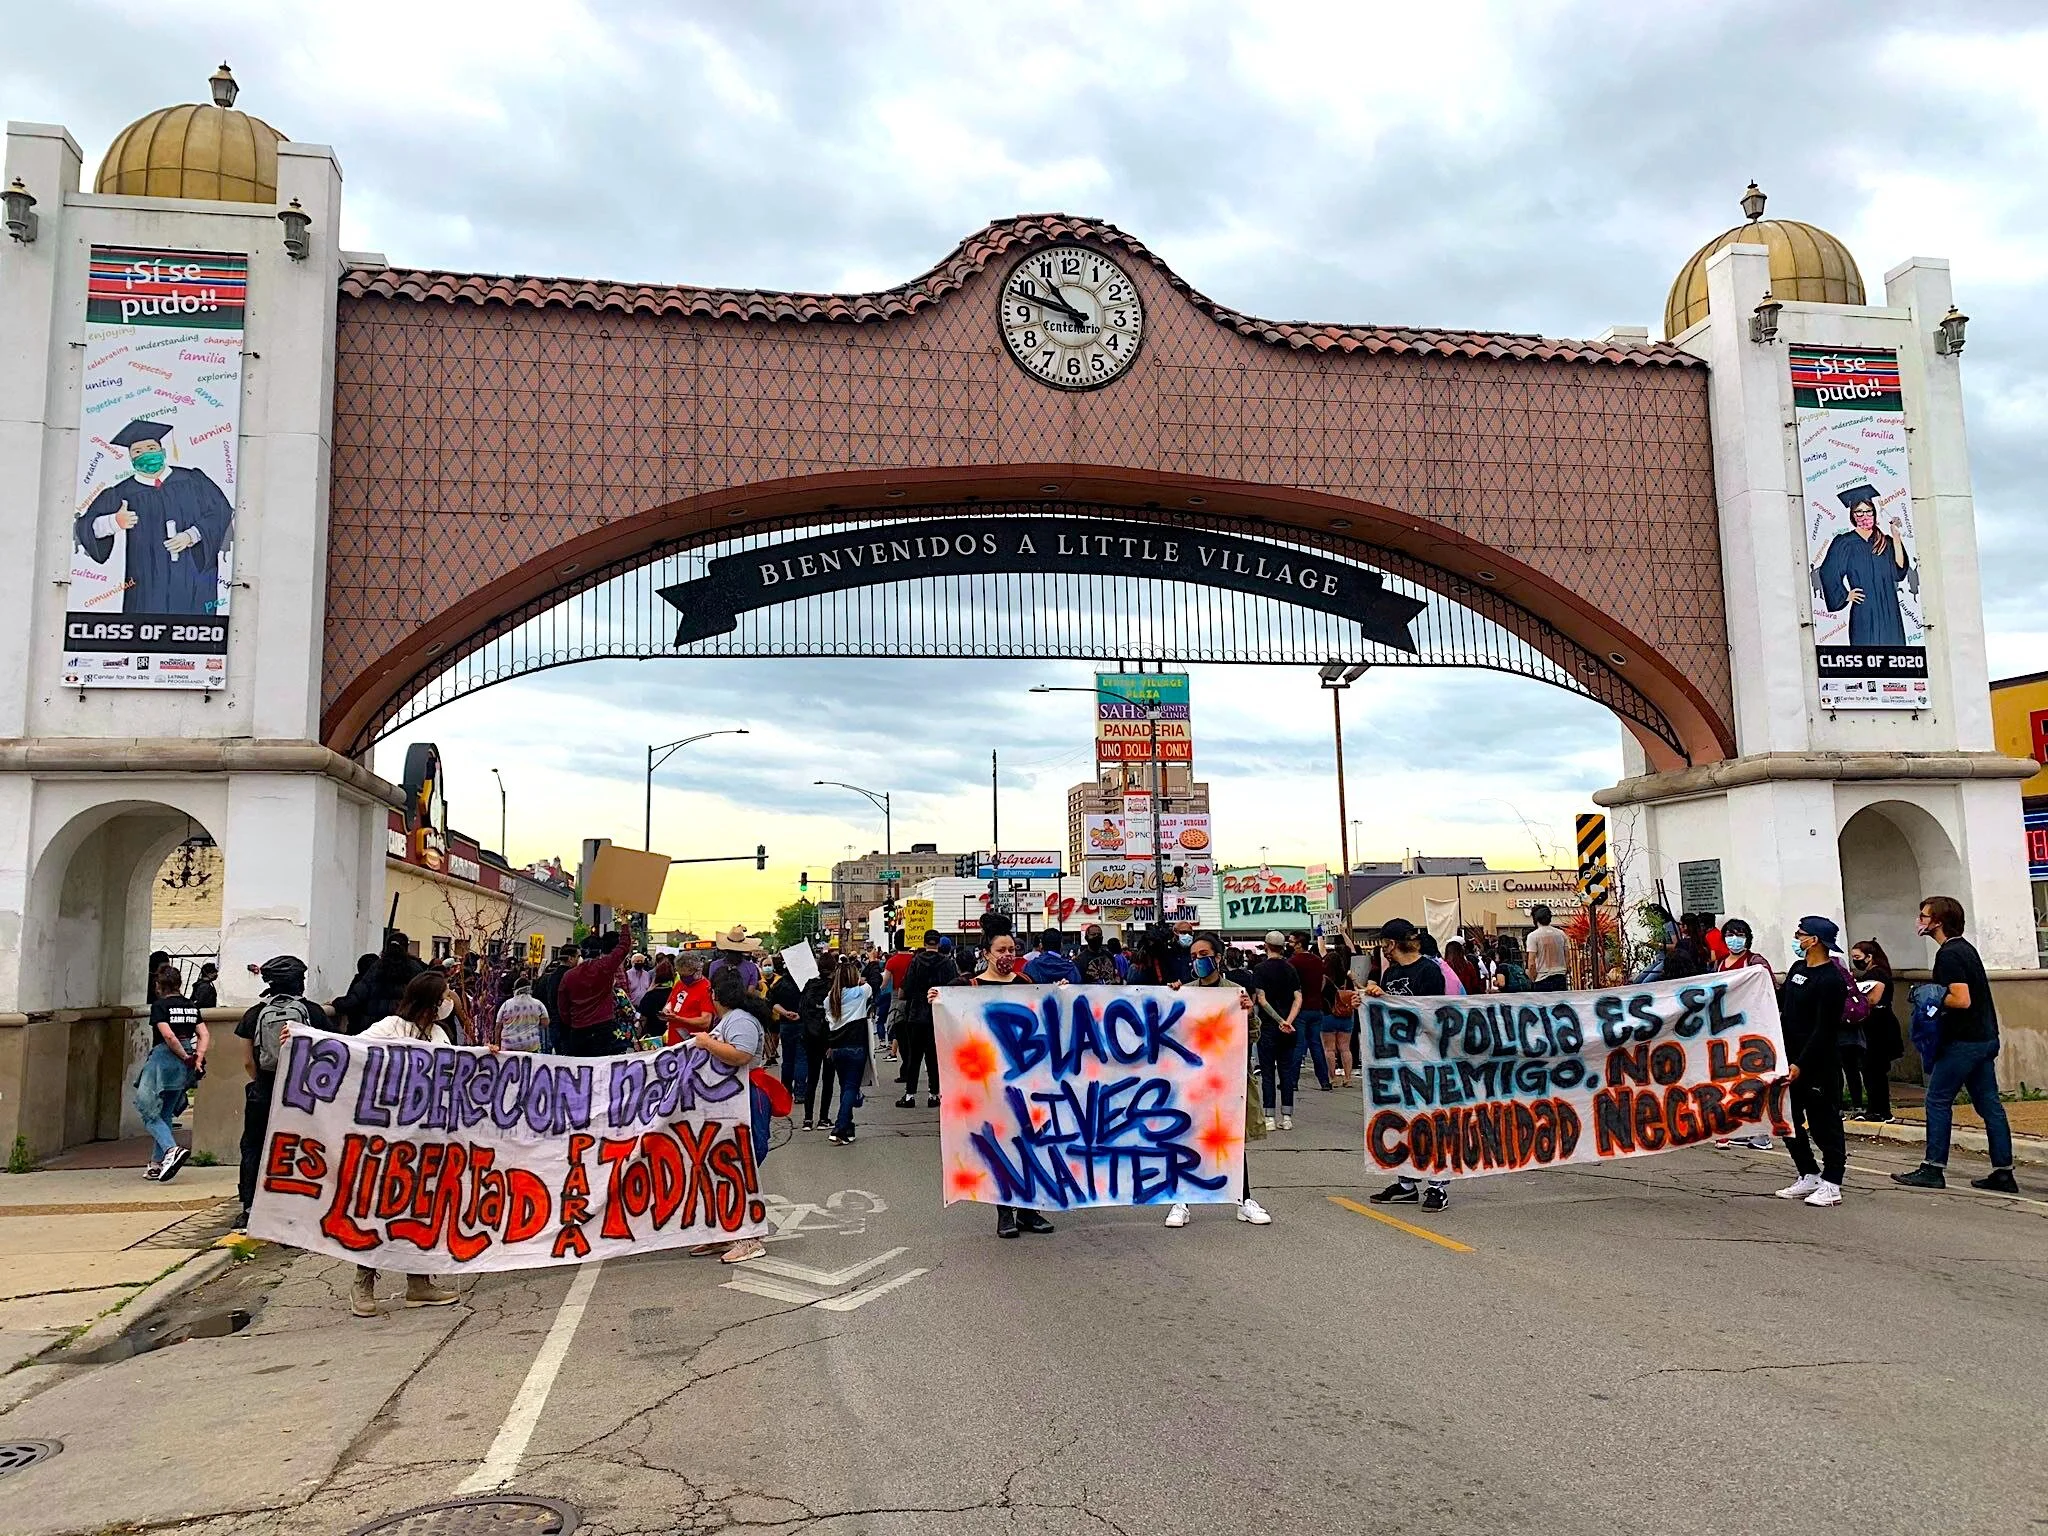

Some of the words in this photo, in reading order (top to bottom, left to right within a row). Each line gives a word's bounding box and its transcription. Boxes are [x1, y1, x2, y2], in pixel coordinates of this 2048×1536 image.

[125, 258, 162, 290] ¡Sí
[168, 263, 200, 282] se
[1040, 262, 1052, 278] 11
[1061, 258, 1080, 275] 12
[1092, 266, 1099, 282] 1
[1018, 280, 1036, 296] 10
[1108, 284, 1122, 301] 2
[121, 288, 218, 324] pudo!!
[1017, 306, 1030, 323] 9
[1043, 320, 1100, 334] Centenario
[1114, 310, 1126, 327] 3
[88, 326, 136, 341] enjoying
[204, 336, 243, 347] changing
[1024, 330, 1037, 348] 8
[1106, 334, 1118, 350] 4
[136, 334, 199, 351] understanding
[88, 345, 129, 371] celebrating
[178, 349, 226, 364] familia
[1042, 350, 1056, 368] 7
[1092, 354, 1104, 371] 5
[128, 360, 173, 381] respecting
[1067, 358, 1080, 375] 6
[1816, 354, 1839, 380] ¡Sí
[1844, 356, 1866, 374] se
[86, 376, 123, 391] uniting
[197, 371, 238, 386] exploring
[86, 396, 122, 414] together
[125, 392, 134, 400] as
[136, 386, 152, 396] one
[154, 388, 196, 406] amig@s
[194, 386, 224, 408] amor
[1816, 378, 1882, 408] pudo!!
[130, 406, 178, 421] supporting
[1799, 409, 1830, 422] enjoying
[1876, 418, 1905, 426] changing
[1831, 415, 1874, 431] understanding
[189, 422, 232, 447] learning
[1862, 428, 1894, 440] familia
[90, 434, 124, 461] growing
[1828, 438, 1860, 454] respecting
[1876, 446, 1905, 457] exploring
[223, 440, 234, 484] connecting
[1803, 452, 1828, 463] uniting
[84, 452, 105, 485] creating
[1876, 459, 1898, 477] amor
[1836, 475, 1868, 490] supporting
[1812, 501, 1836, 520] growing
[758, 534, 998, 586] BIENVENIDOS
[1017, 534, 1037, 554] A
[1058, 534, 1180, 562] LITTLE
[1198, 546, 1339, 596] VILLAGE
[71, 568, 108, 582] cultura
[84, 577, 136, 608] comunidad
[204, 598, 228, 612] paz
[1814, 608, 1838, 620] cultura
[1899, 600, 1922, 630] laughing
[68, 623, 134, 640] CLASS
[140, 624, 166, 641] OF
[172, 625, 224, 642] 2020
[1908, 632, 1924, 644] paz
[1820, 654, 1862, 668] CLASS
[1867, 655, 1884, 668] OF
[1888, 656, 1924, 668] 2020
[1100, 704, 1136, 718] SAH
[1104, 724, 1184, 736] PANADERIA
[1102, 744, 1120, 756] UNO
[1166, 744, 1188, 756] ONLY
[1102, 864, 1108, 872] EL
[1110, 864, 1126, 872] POLLO
[1468, 879, 1499, 893] SAH
[1226, 895, 1308, 919] PIZZER
[1516, 898, 1582, 908] ESPERANZ
[1134, 906, 1154, 920] COIN
[1596, 994, 1663, 1048] ES
[1674, 984, 1746, 1039] EL
[983, 994, 1203, 1080] BLACK
[1367, 1057, 1600, 1108] ENEMIGO.
[1605, 1040, 1686, 1087] NO
[1005, 1076, 1192, 1146] LIVES
[970, 1121, 1228, 1207] MATTER
[266, 1131, 328, 1180] ES
[551, 1133, 596, 1258] PARA
